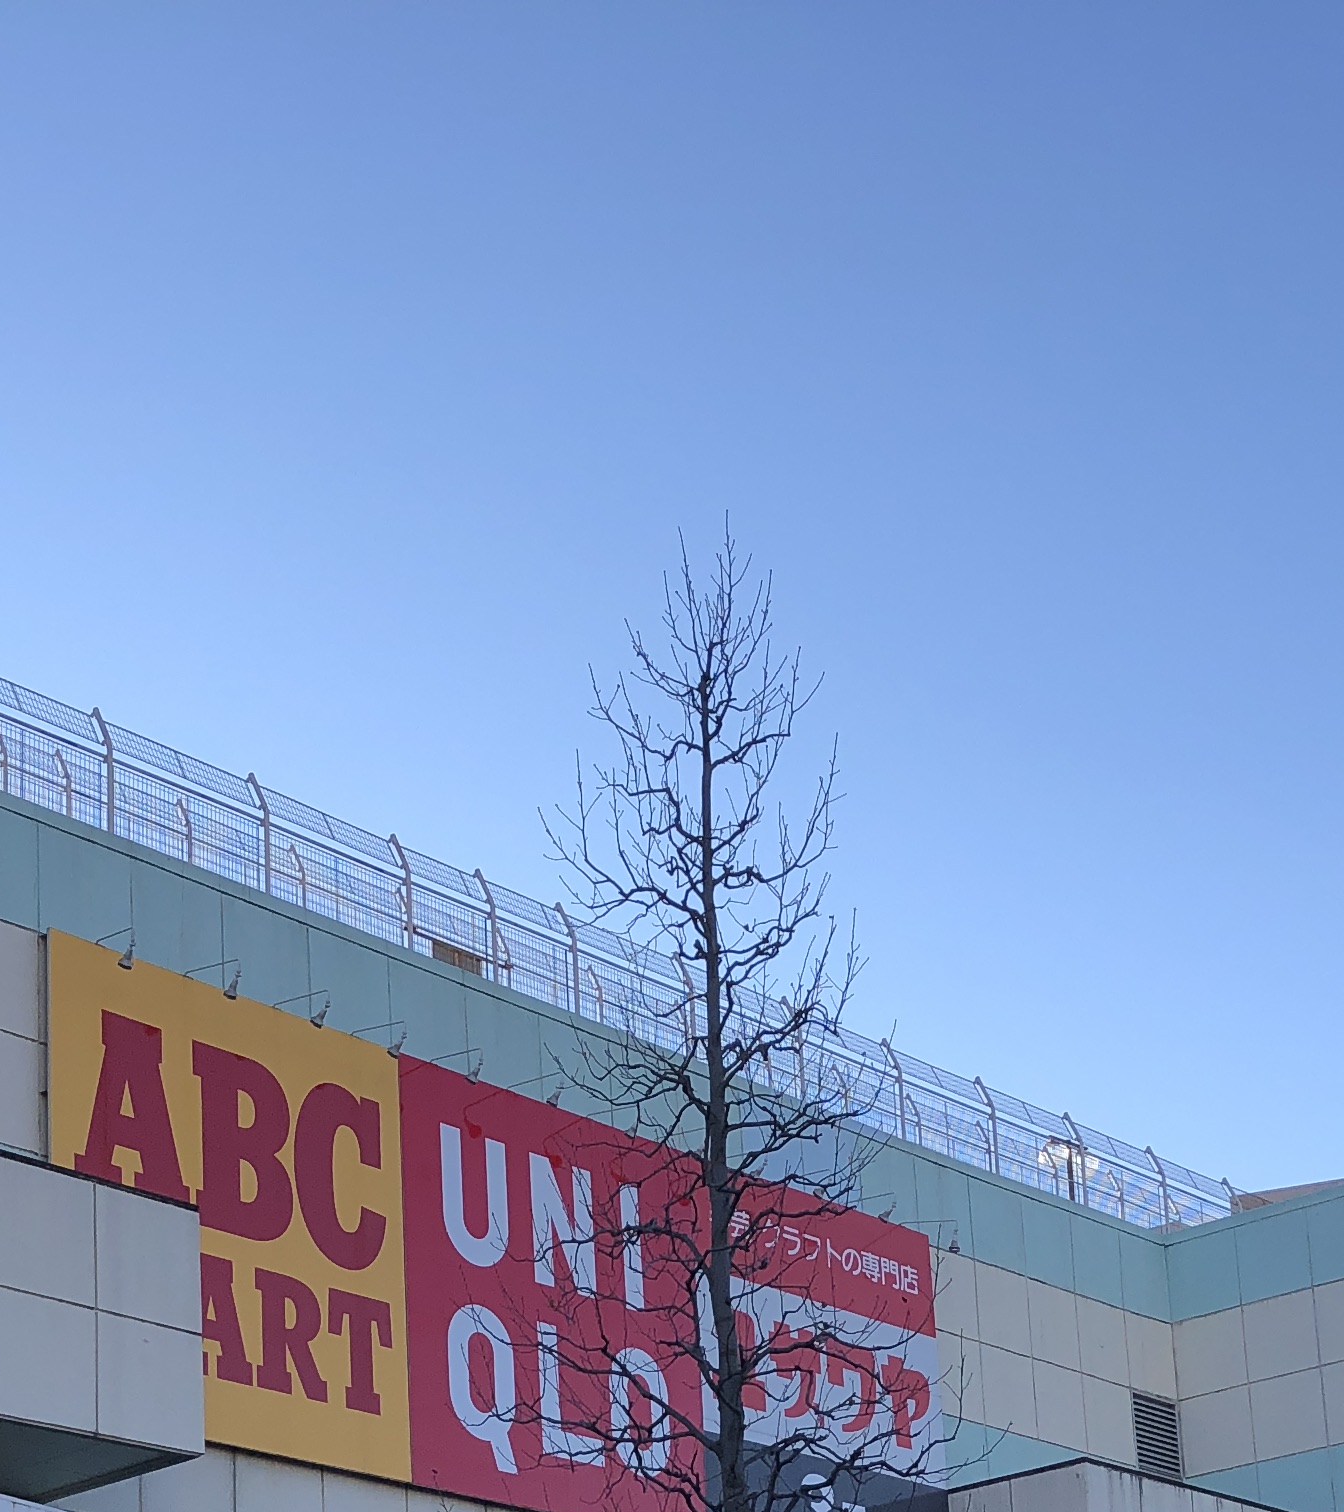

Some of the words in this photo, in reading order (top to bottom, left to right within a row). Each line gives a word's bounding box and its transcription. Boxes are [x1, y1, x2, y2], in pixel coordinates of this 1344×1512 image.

[74, 1009, 388, 1270] ABC
[439, 1121, 645, 1312] UNI
[201, 1254, 393, 1417] ART
[447, 1303, 670, 1477] QLO
